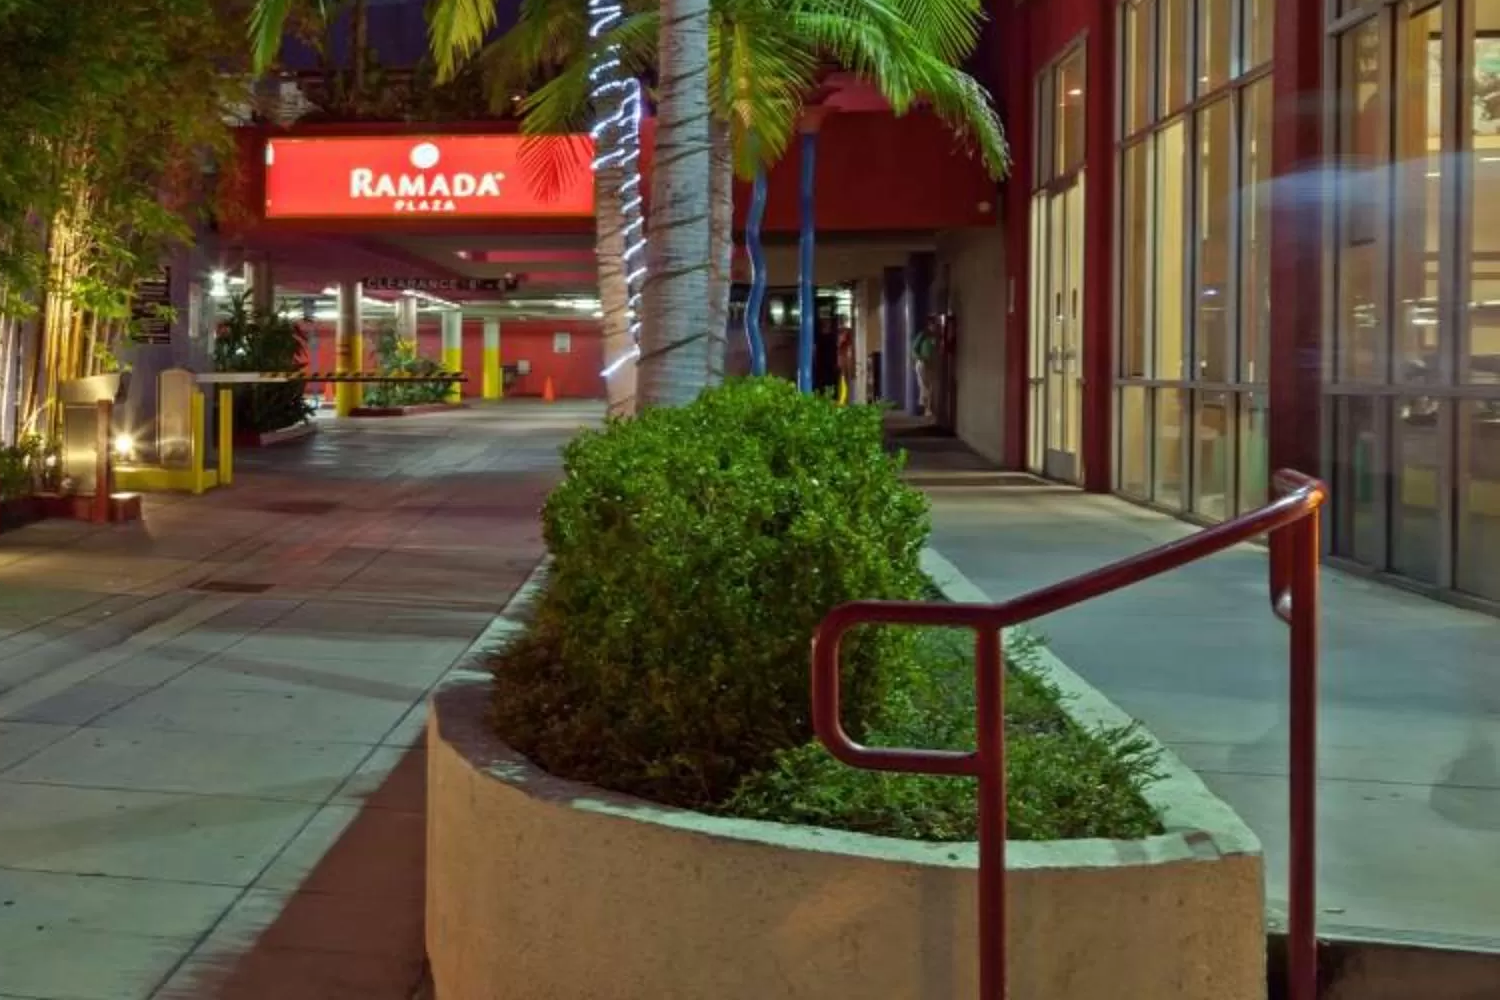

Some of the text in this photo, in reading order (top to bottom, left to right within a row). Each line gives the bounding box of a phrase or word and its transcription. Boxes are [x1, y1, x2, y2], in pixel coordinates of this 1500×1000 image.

[350, 167, 503, 198] RAMADA
[394, 199, 456, 212] PLAZA
[367, 277, 457, 290] CLEARANCE
